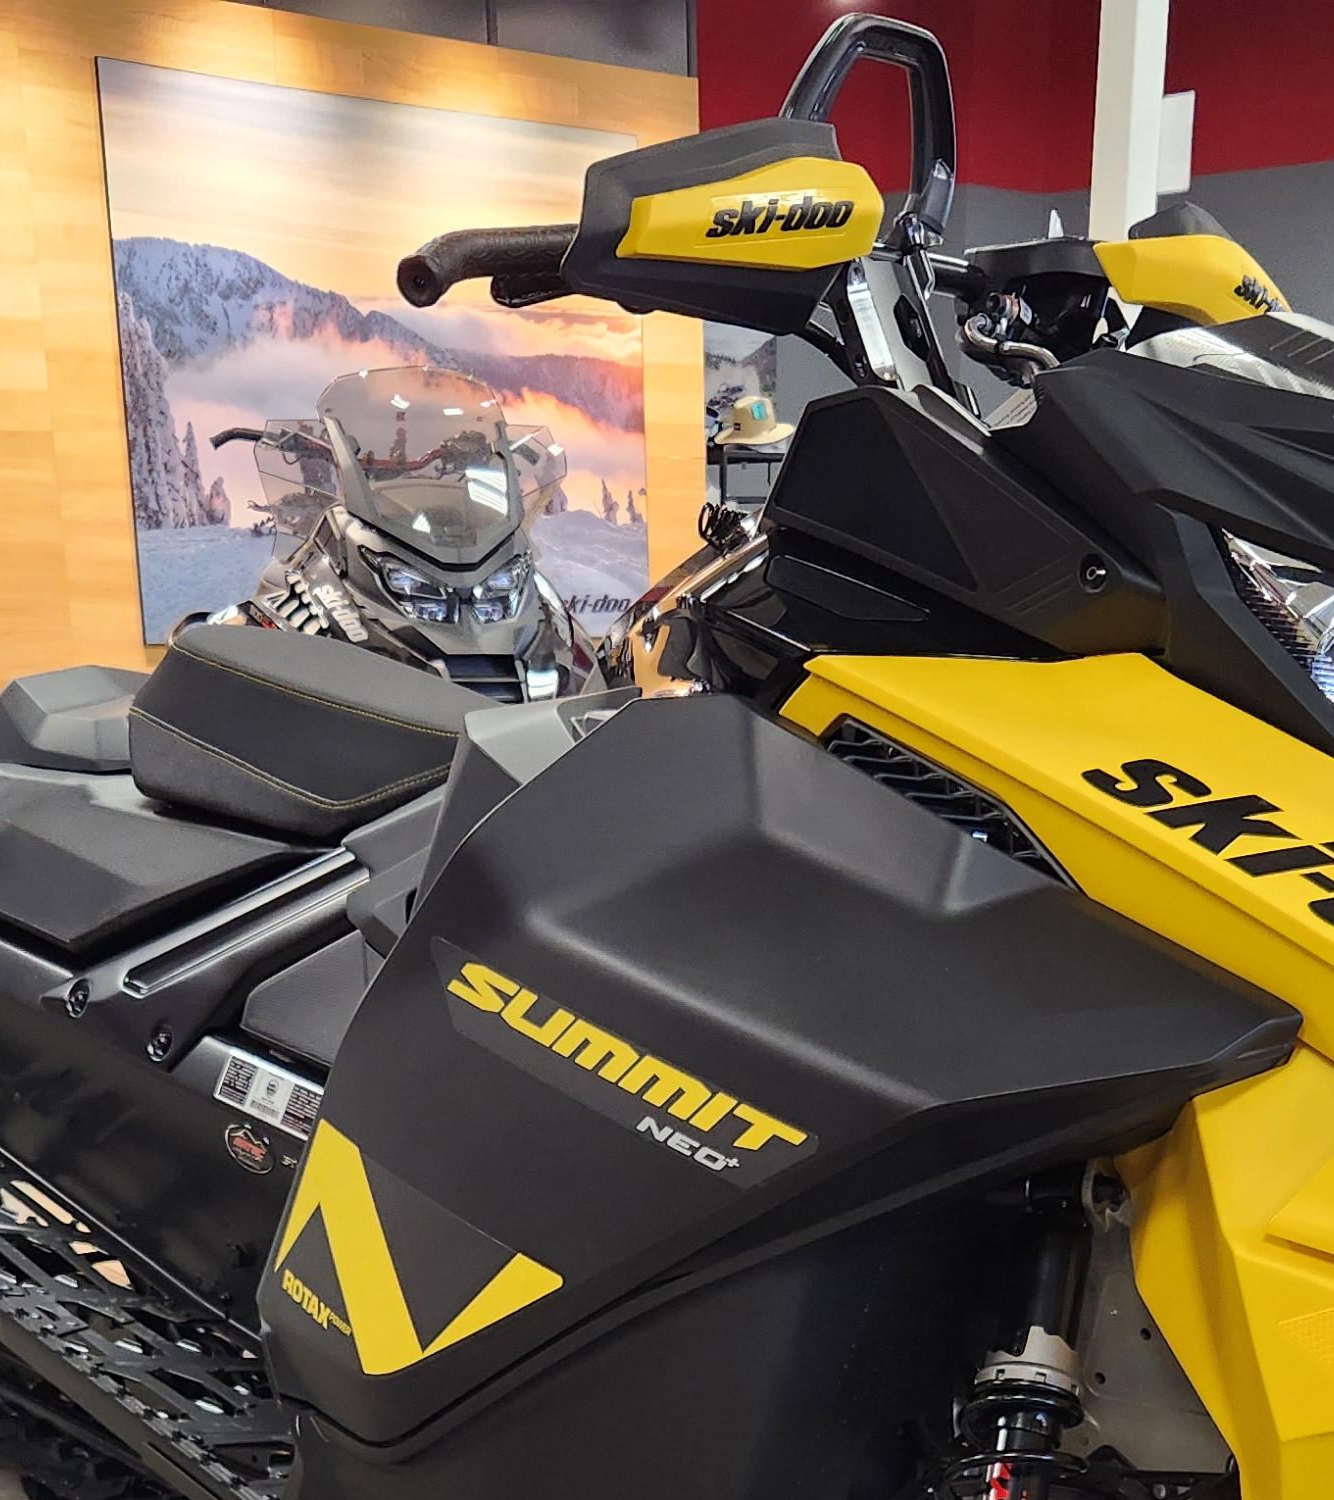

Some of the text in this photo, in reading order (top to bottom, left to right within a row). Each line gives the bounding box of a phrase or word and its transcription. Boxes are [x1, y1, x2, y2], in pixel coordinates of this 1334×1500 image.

[705, 196, 855, 238] ski-doo
[312, 585, 369, 642] ski-doo
[564, 594, 631, 614] ki-doo
[447, 962, 808, 1151] SUMMIT
[282, 1268, 352, 1337] ROTAX POWER
